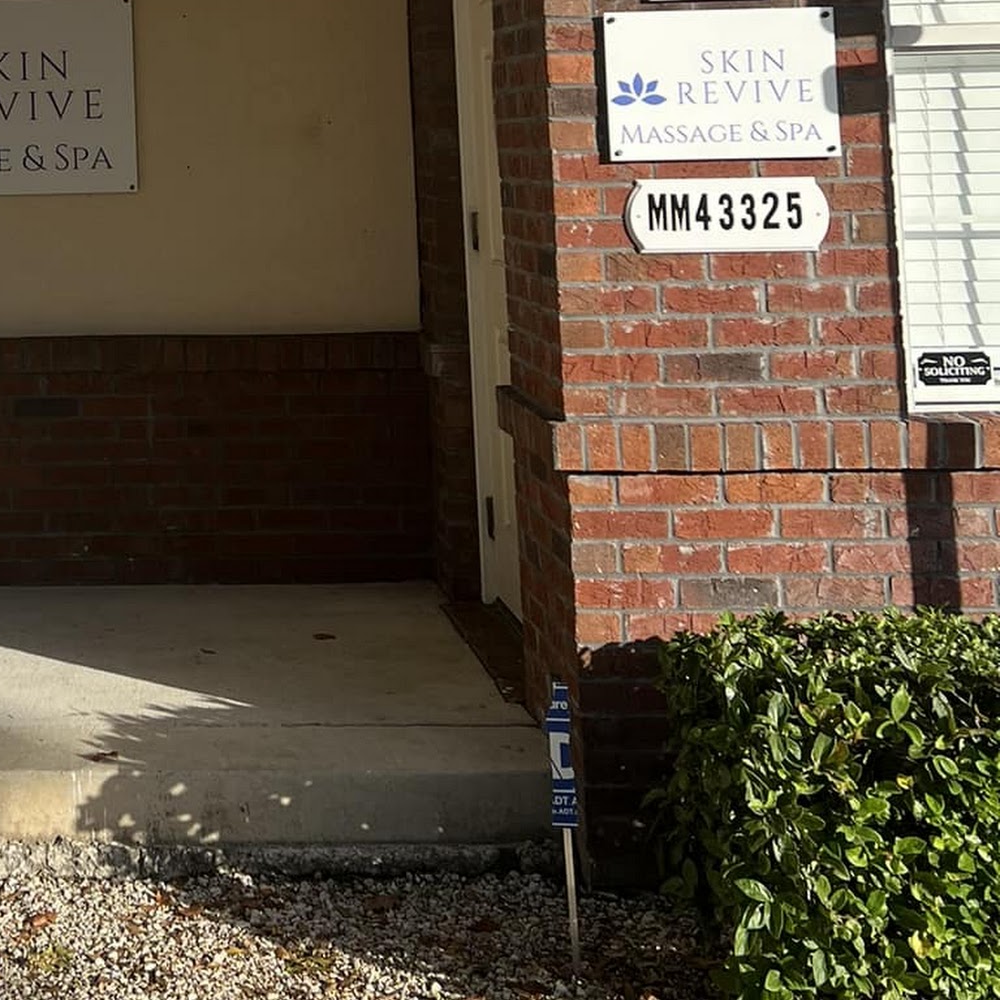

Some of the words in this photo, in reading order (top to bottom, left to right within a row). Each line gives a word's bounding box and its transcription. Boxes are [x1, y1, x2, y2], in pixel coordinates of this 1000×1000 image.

[700, 48, 786, 74] SKIN
[677, 78, 814, 106] REVIVE
[750, 121, 769, 142] &
[22, 144, 47, 171] &
[647, 191, 803, 232] MM43325
[924, 366, 986, 377] SOLICITING
[942, 355, 966, 367] NO
